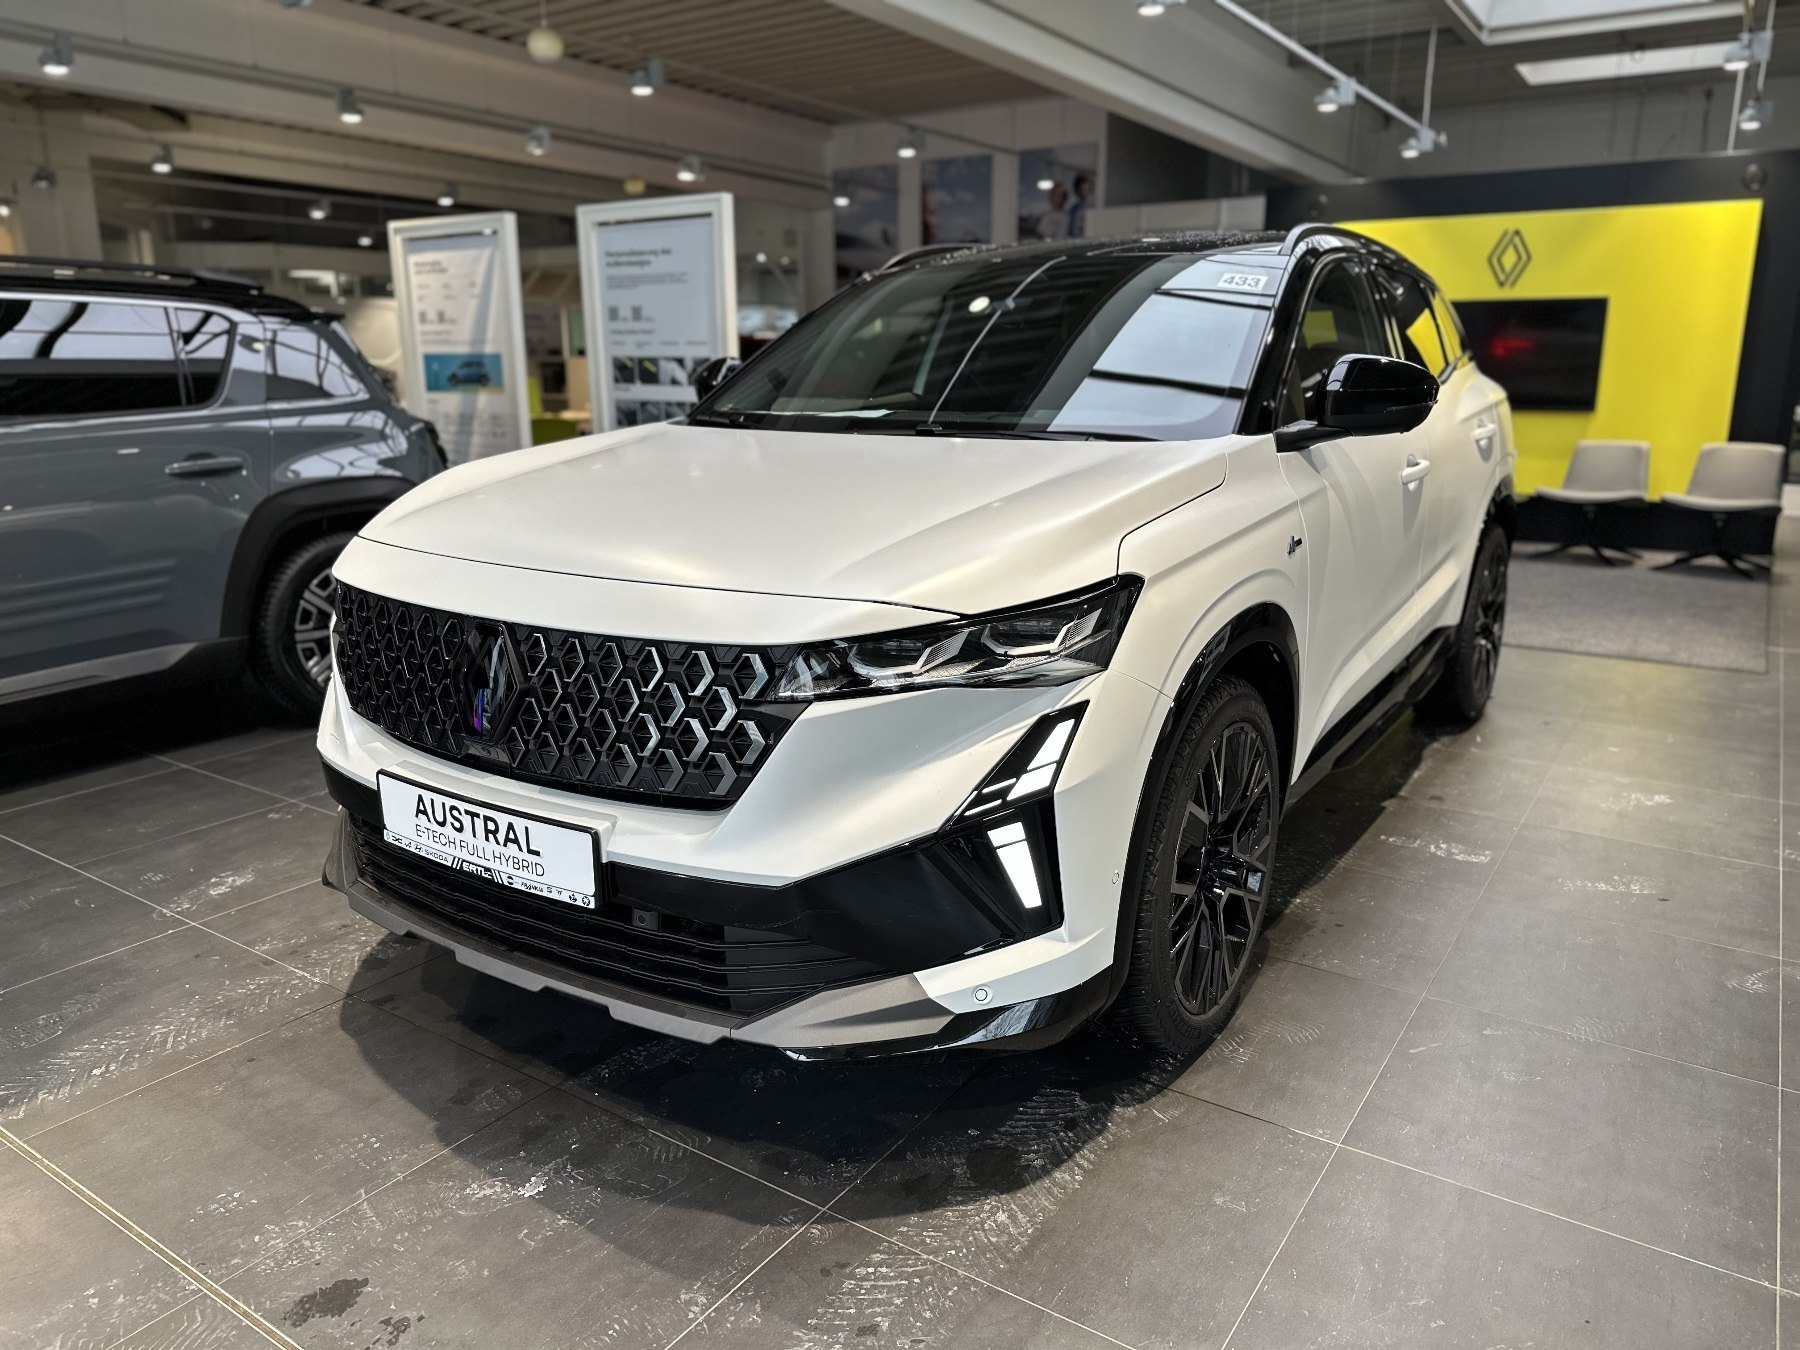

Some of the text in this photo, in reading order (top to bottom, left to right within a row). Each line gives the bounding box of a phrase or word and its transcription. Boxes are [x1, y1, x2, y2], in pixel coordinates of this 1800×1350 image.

[1222, 275, 1262, 289] 433
[414, 793, 541, 857] AUSTRAL
[415, 823, 545, 877] E-TECH FULL HYBRID
